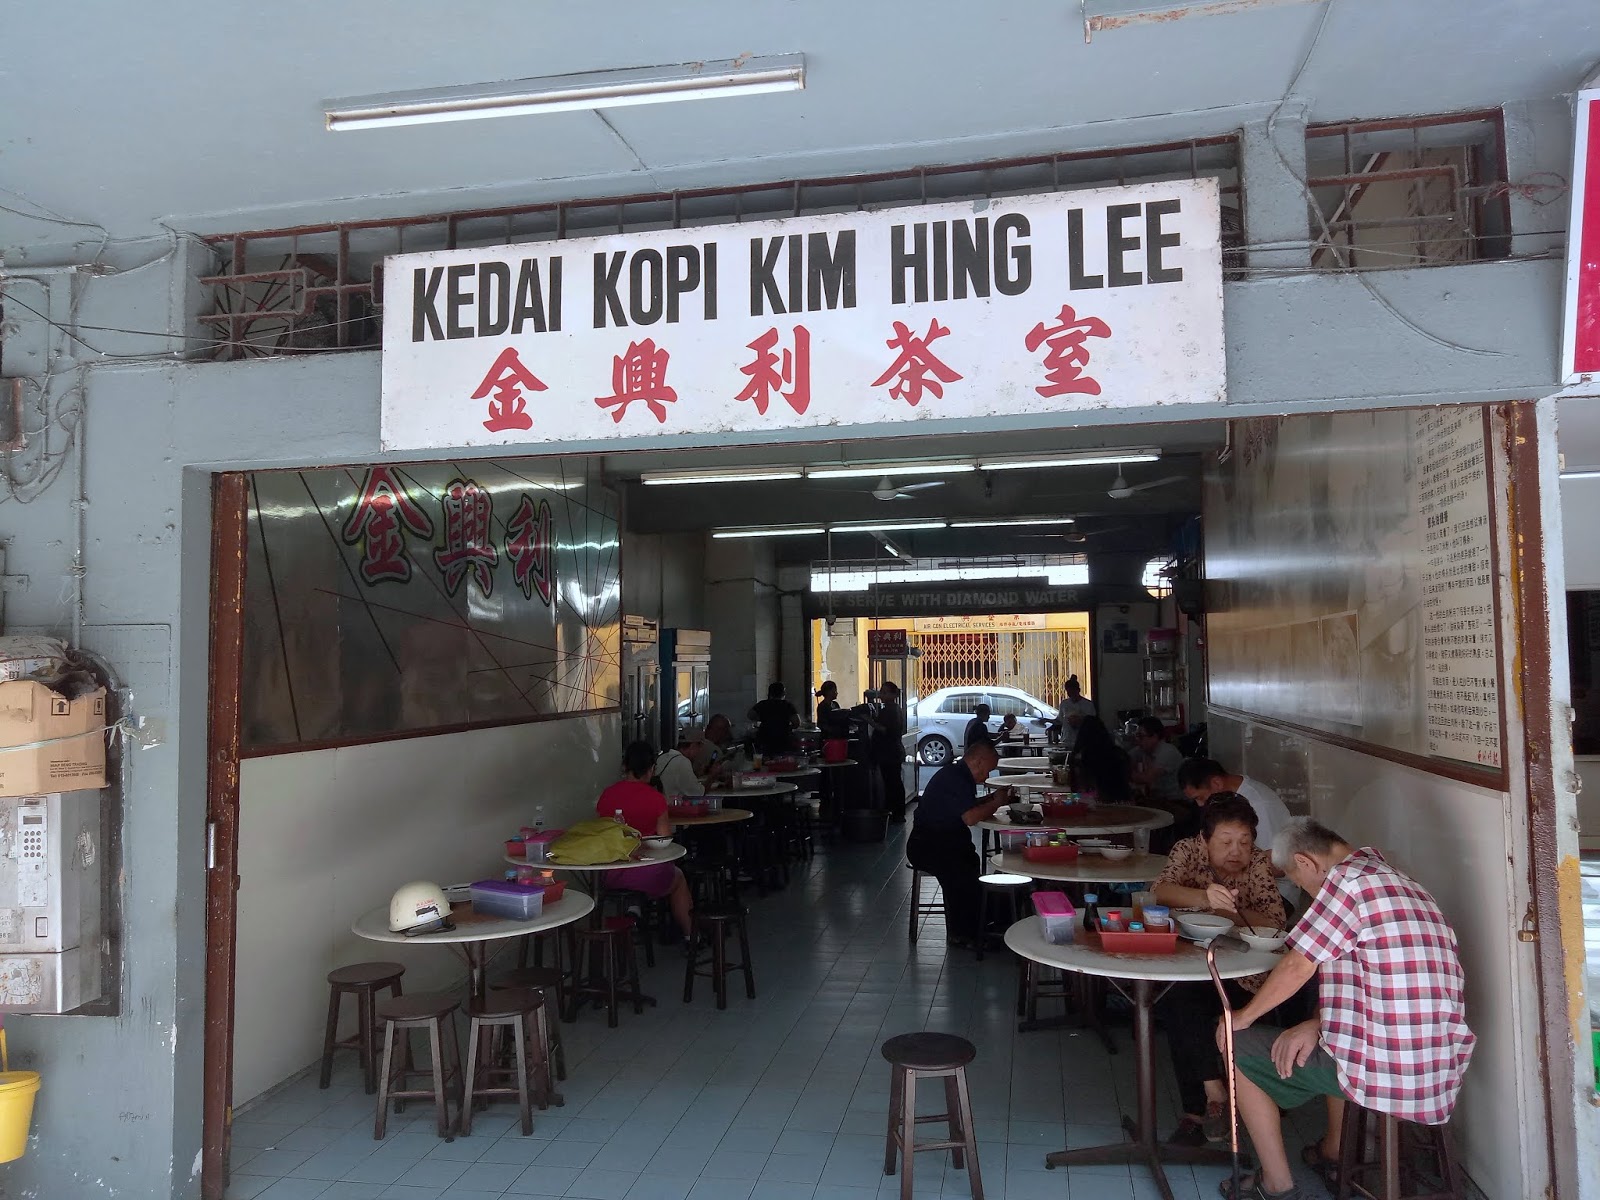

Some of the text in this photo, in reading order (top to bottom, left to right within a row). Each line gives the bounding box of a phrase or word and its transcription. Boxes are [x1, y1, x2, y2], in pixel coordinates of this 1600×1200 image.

[412, 198, 1183, 343] KEDAI KOPI KIM HING LEE
[472, 304, 1111, 431] 金興利茶室
[342, 467, 551, 606] 金興利
[848, 596, 895, 607] SERVE
[901, 593, 941, 606] WITH
[946, 591, 1019, 606] DIAMOND
[1025, 589, 1079, 604] WATER
